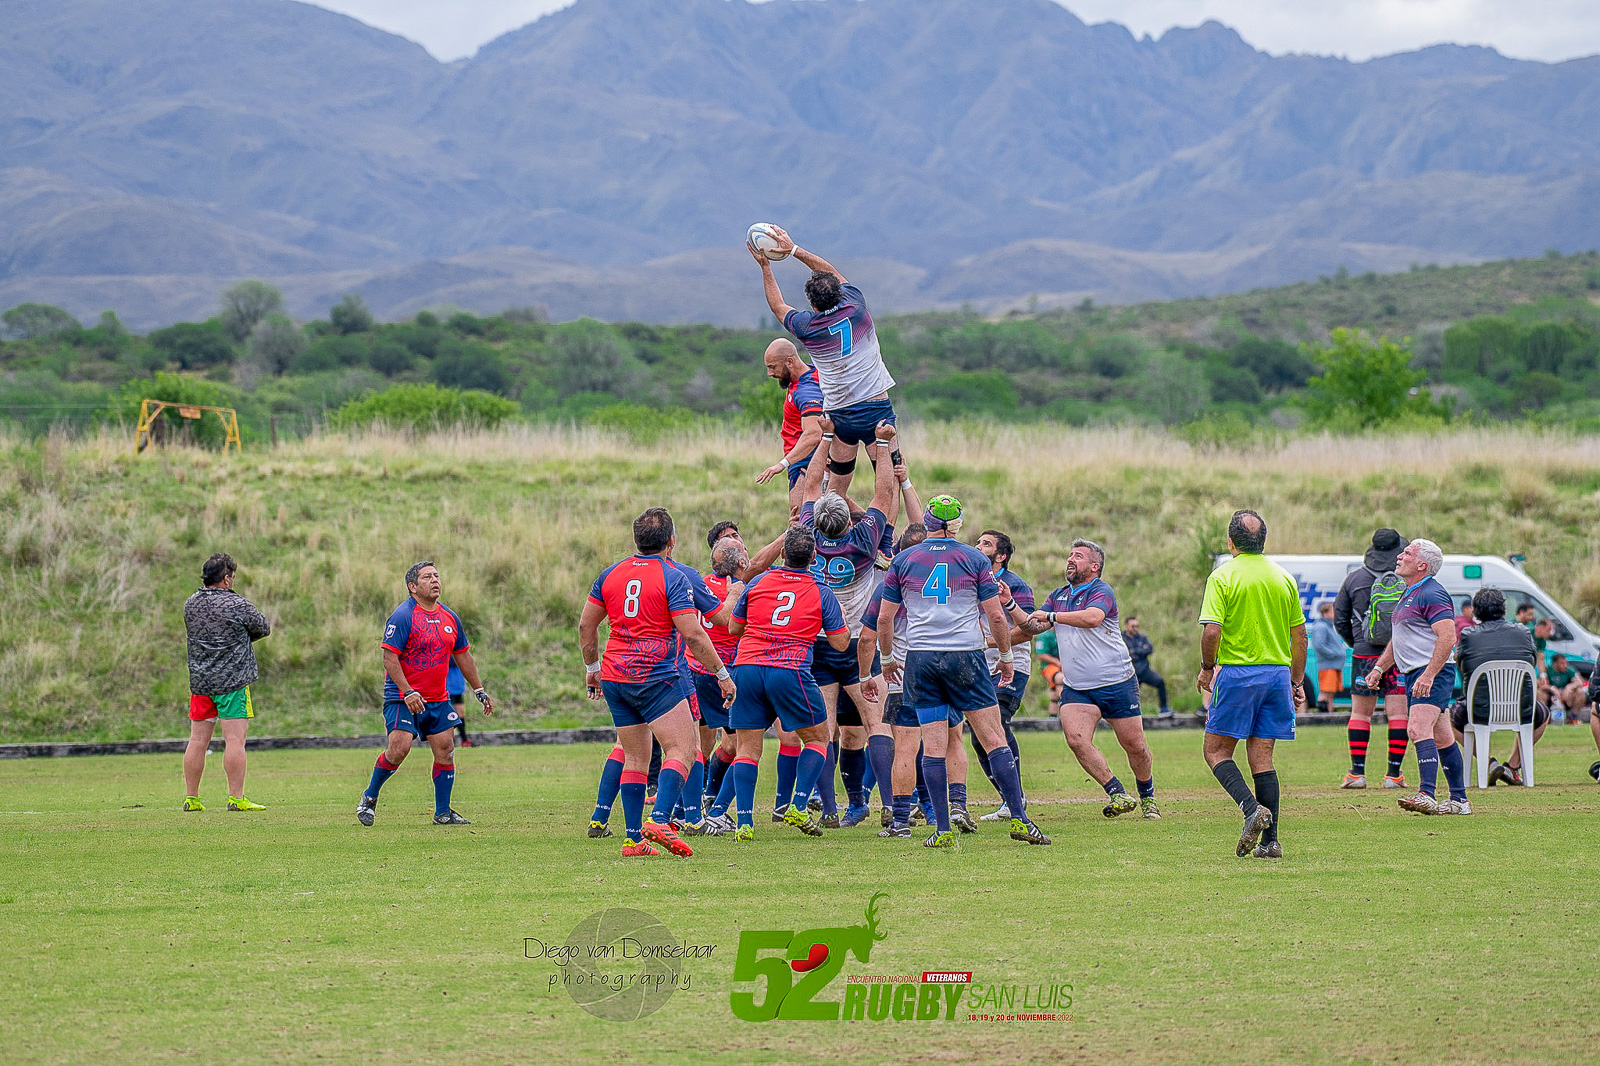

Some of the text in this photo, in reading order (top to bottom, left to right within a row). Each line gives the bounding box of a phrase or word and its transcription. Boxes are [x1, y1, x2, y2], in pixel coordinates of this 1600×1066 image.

[828, 316, 853, 358] 7
[623, 579, 642, 618] 8
[922, 563, 951, 605] 4
[771, 591, 796, 626] 2
